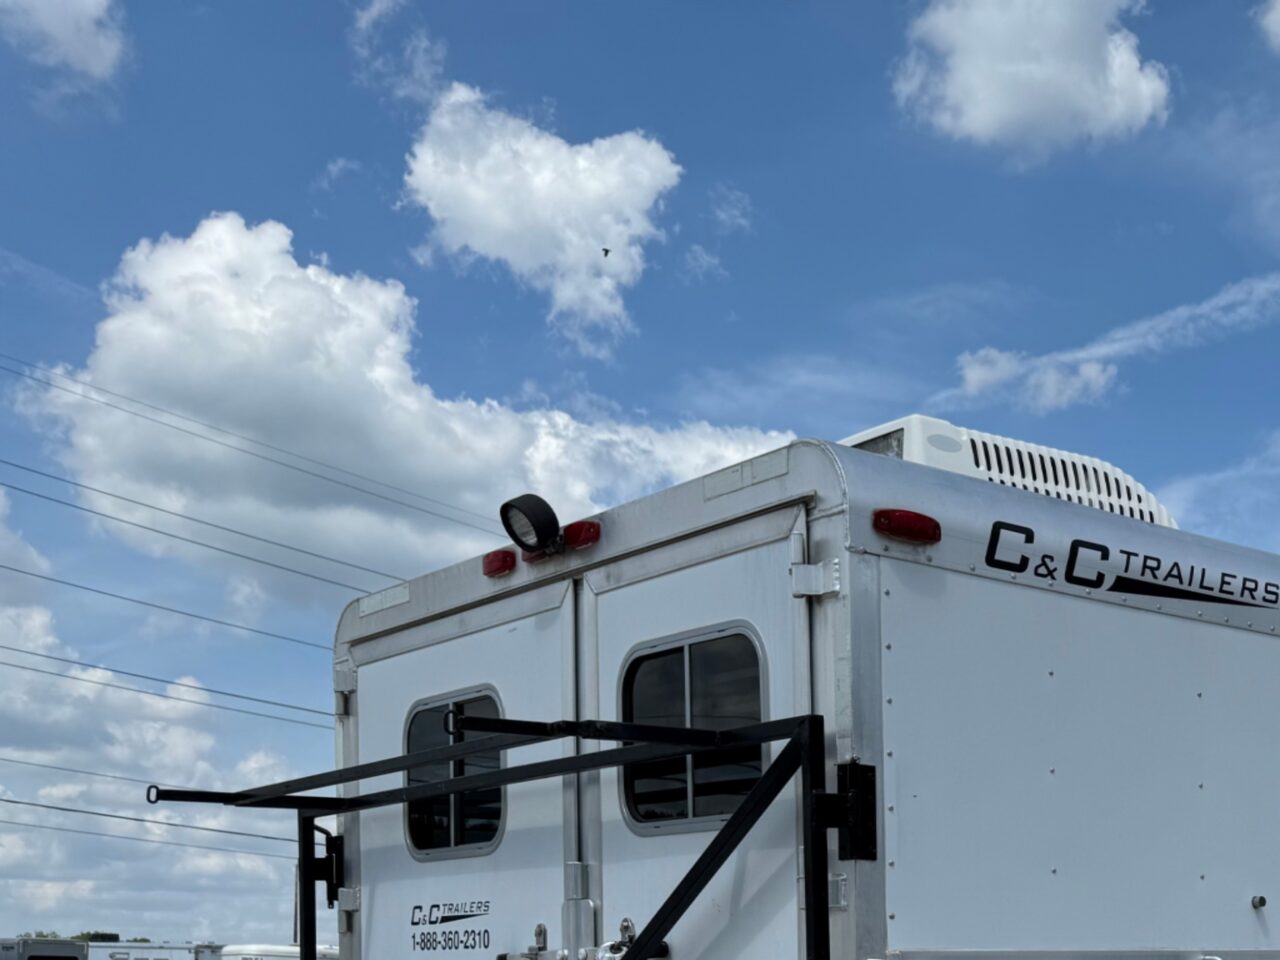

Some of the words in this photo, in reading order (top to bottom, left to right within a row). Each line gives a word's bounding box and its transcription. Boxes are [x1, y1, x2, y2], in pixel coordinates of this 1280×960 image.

[984, 520, 1110, 589] C&C
[1119, 549, 1280, 605] TRAILERS
[441, 900, 491, 915] TRAILERS
[411, 928, 491, 951] 1-888-360-2310
